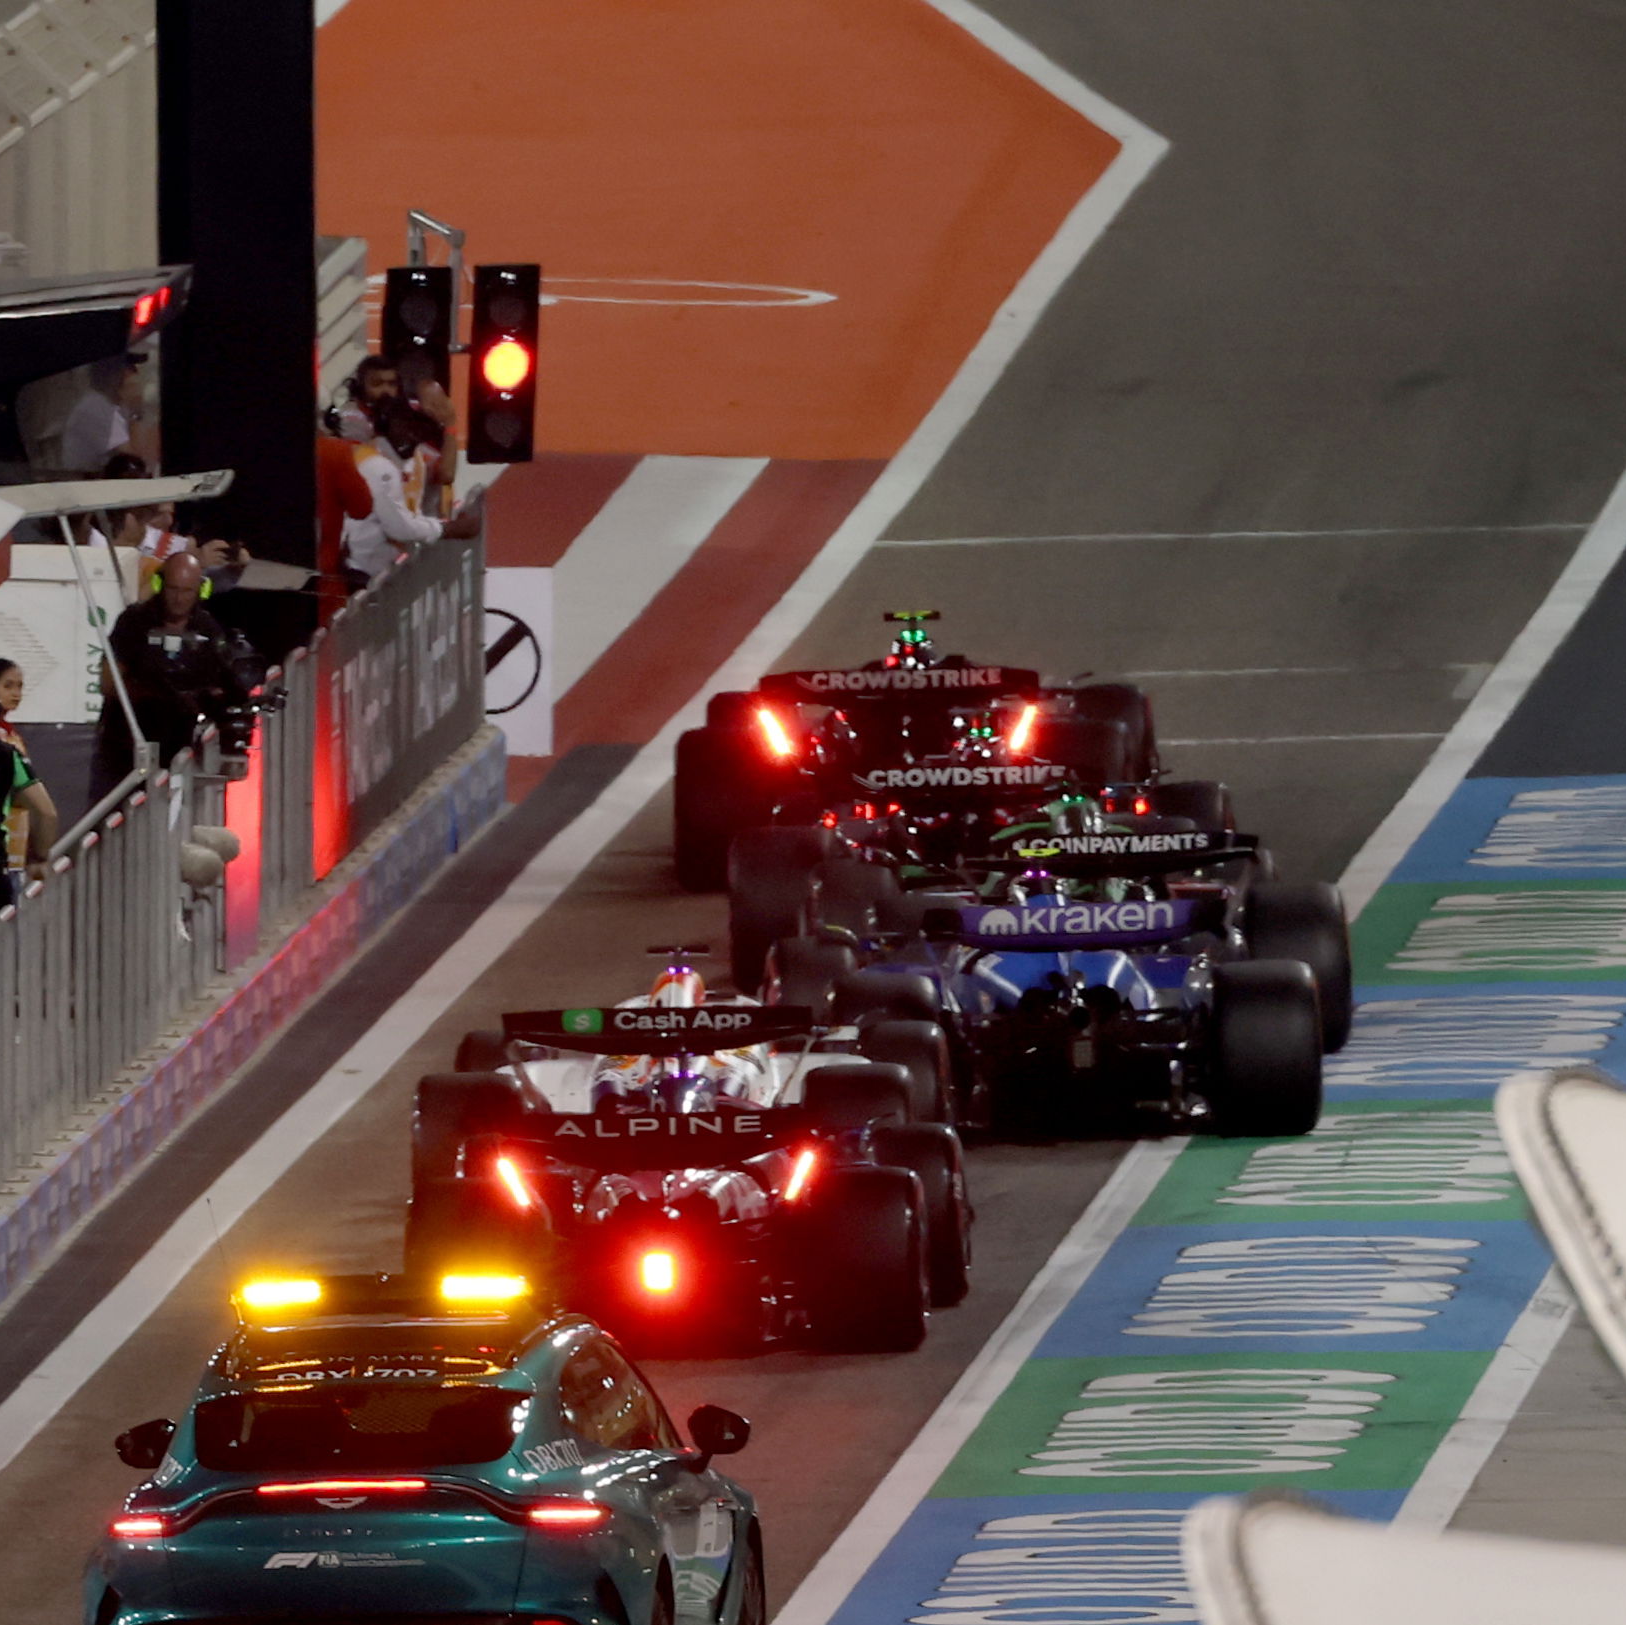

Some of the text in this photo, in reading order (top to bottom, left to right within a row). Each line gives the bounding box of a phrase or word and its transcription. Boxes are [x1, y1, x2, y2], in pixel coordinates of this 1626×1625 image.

[810, 667, 1002, 691] CROWDSTRIKE
[1031, 832, 1209, 856] COINPAYMENTS
[1021, 900, 1175, 936] kraken
[614, 1008, 687, 1031] Cash
[693, 1010, 752, 1031] App
[554, 1113, 765, 1138] ALPINE
